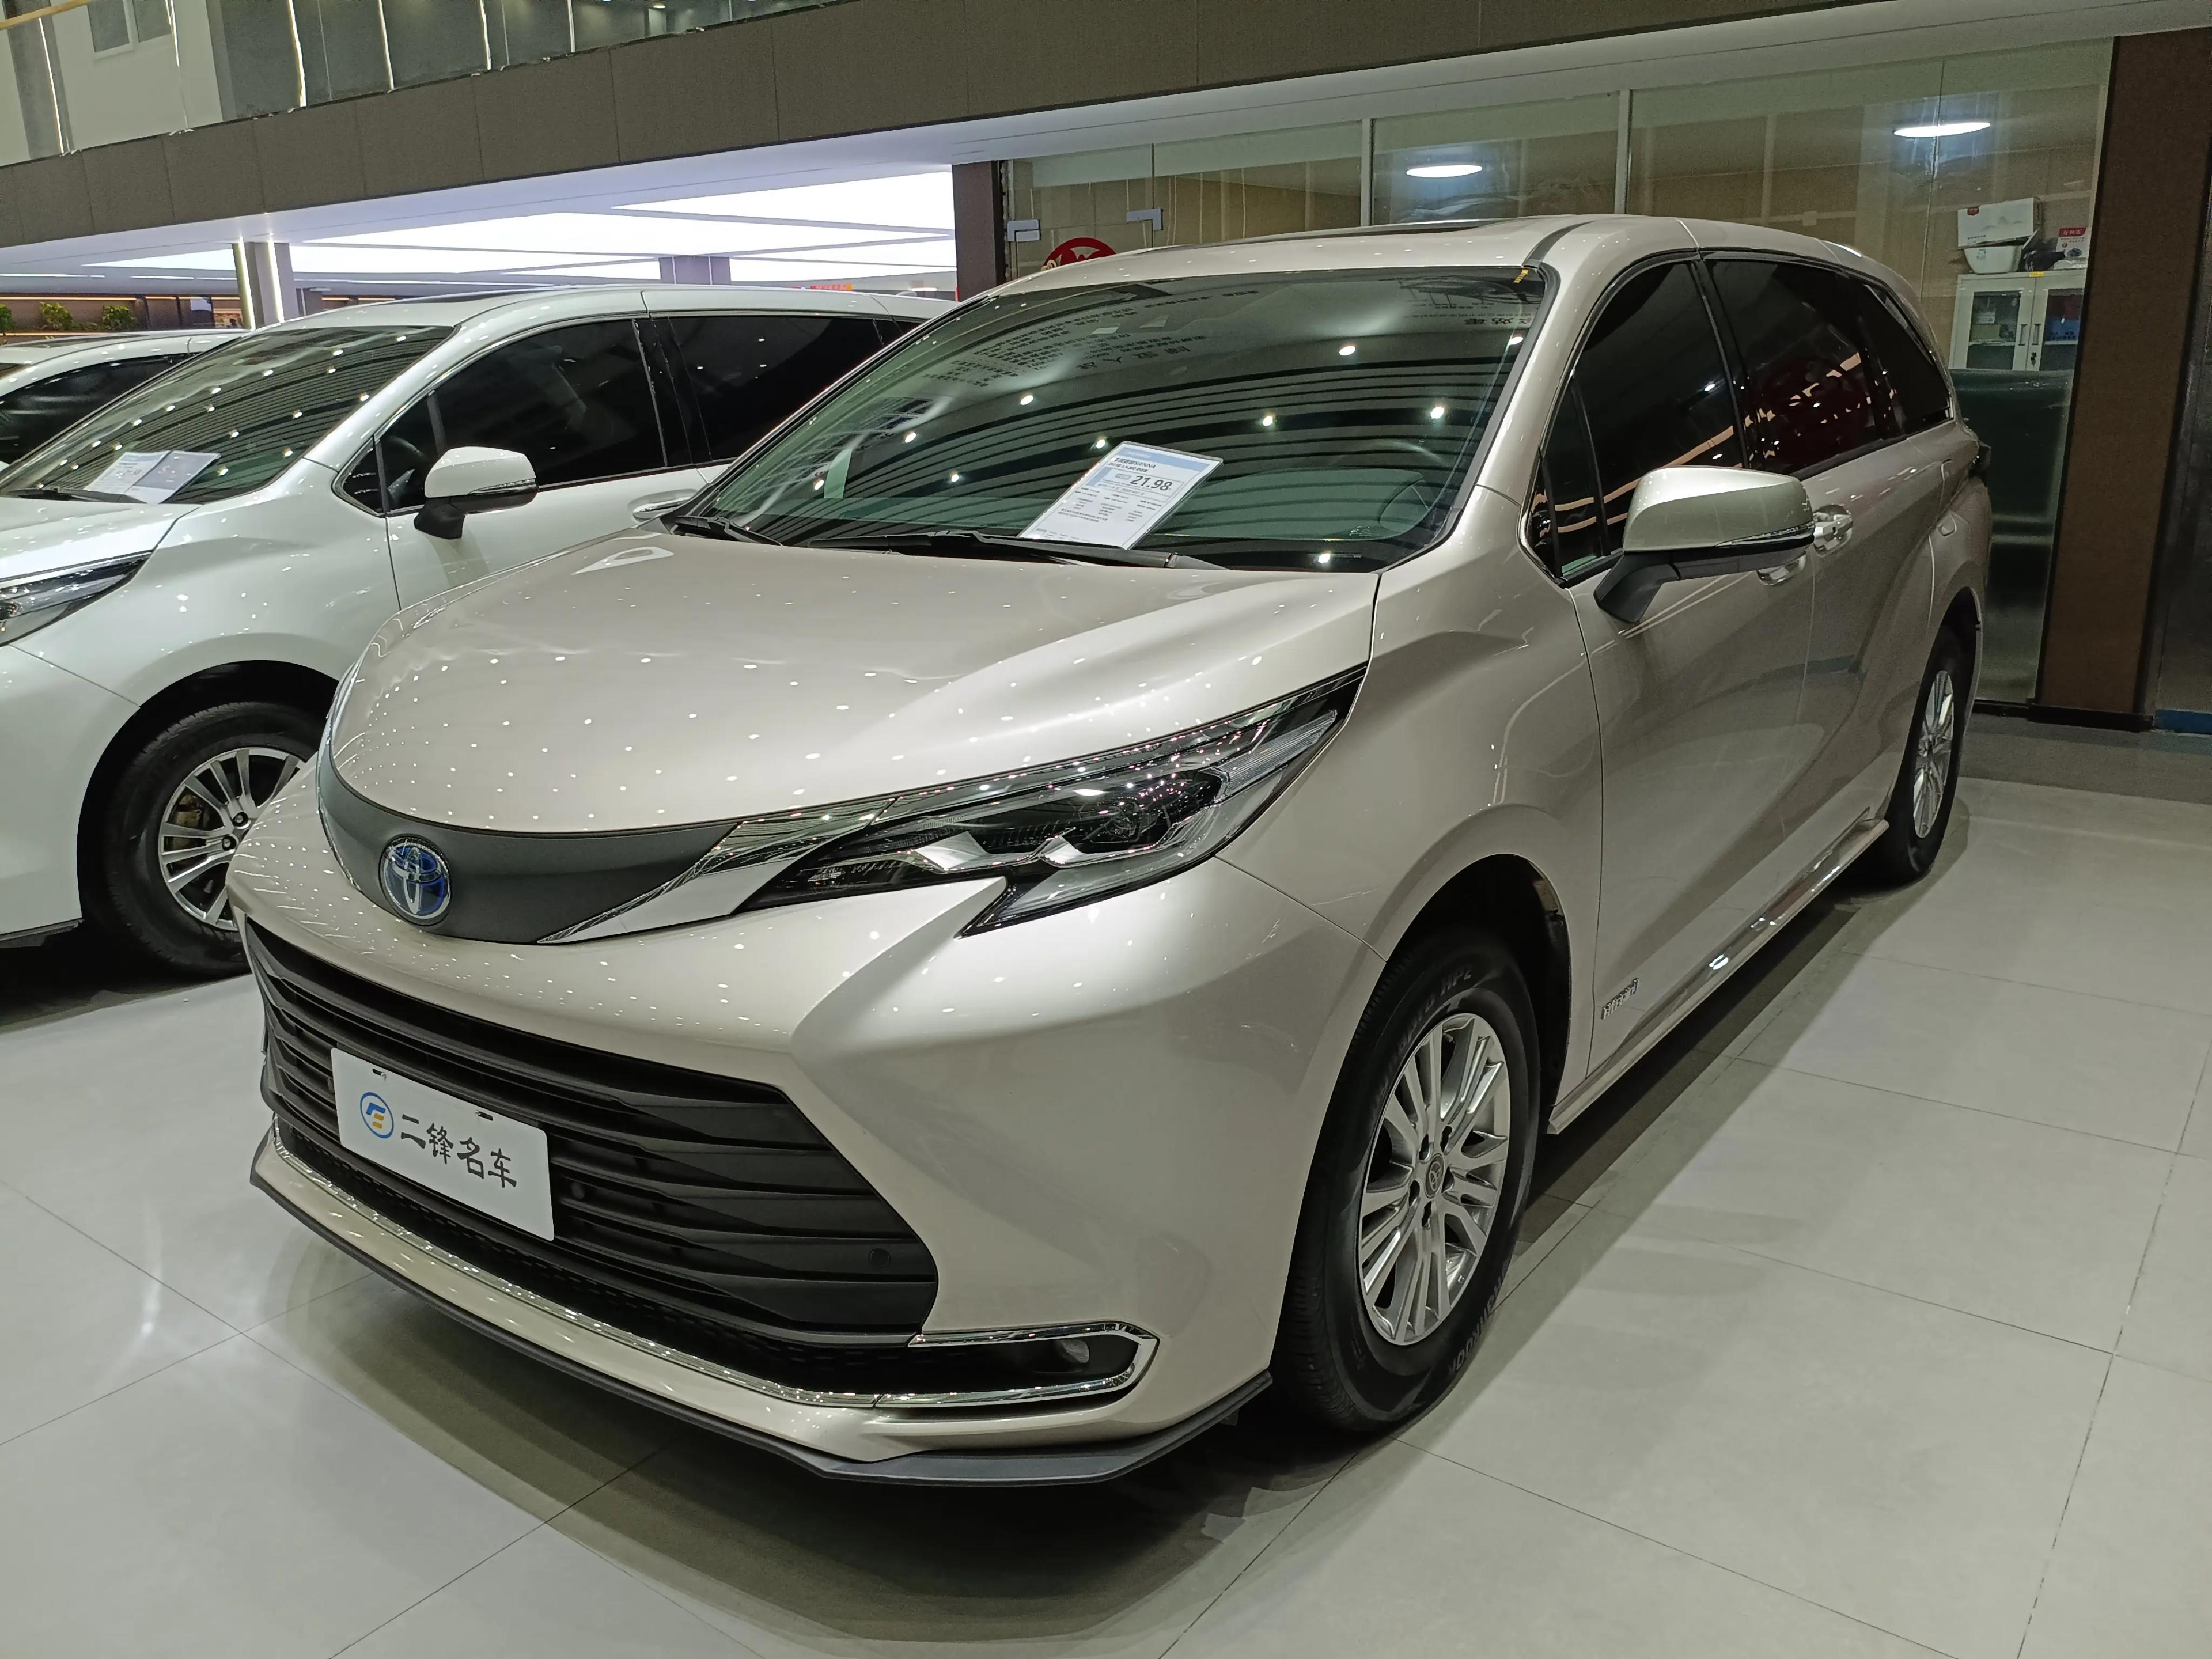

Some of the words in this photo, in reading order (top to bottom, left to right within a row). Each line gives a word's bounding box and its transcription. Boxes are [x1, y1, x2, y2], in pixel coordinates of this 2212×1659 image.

[1130, 475, 1173, 491] 21.98
[400, 1114, 517, 1188] 二锋名车
